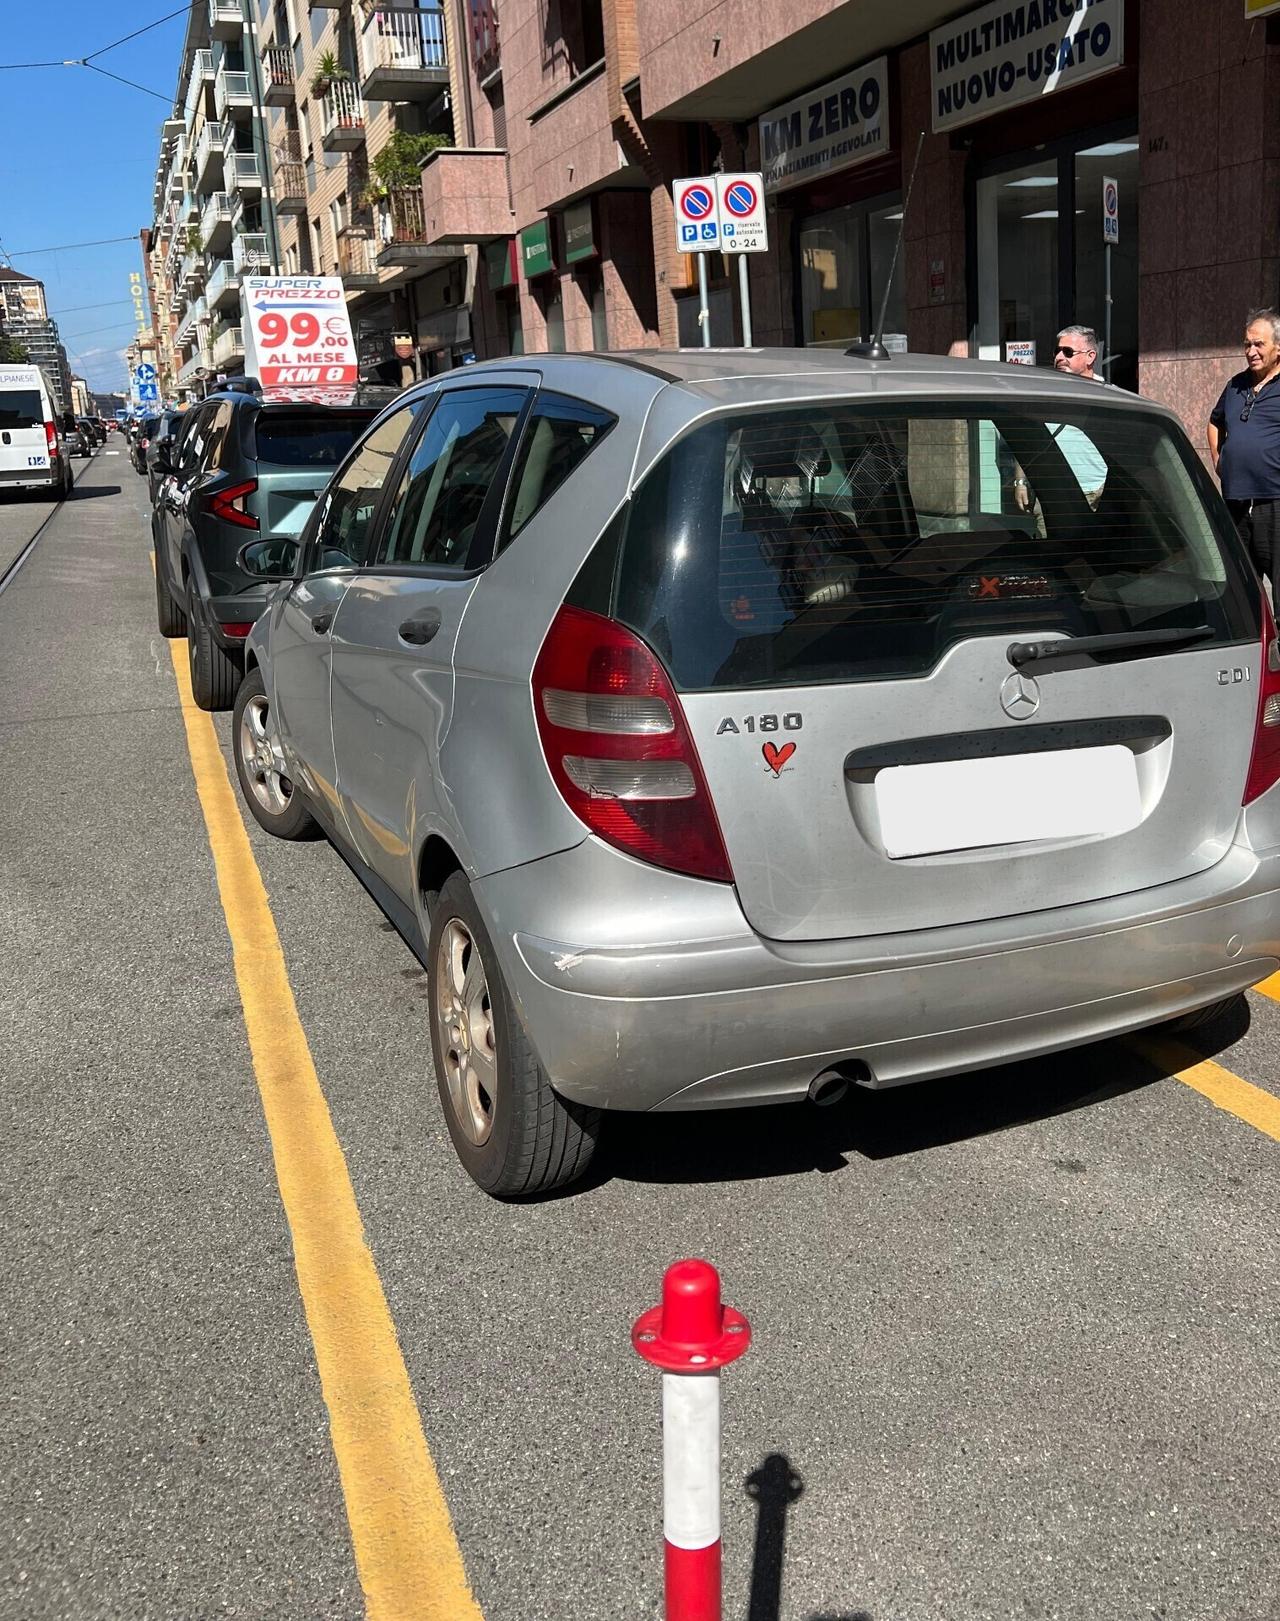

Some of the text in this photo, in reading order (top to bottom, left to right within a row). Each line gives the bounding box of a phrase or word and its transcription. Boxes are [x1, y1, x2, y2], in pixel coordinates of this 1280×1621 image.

[937, 0, 1104, 73] MULTIMARC
[938, 22, 1111, 117] NUOVO-USATO
[763, 77, 880, 161] KM ZERO
[831, 126, 881, 160] AGEVOLATI
[730, 239, 737, 248] 0
[744, 238, 757, 248] 24
[249, 279, 321, 288] SUPER
[255, 290, 340, 299] PREZZO
[258, 312, 321, 348] 99
[268, 352, 345, 365] AL MESE
[277, 367, 321, 383] KM
[1217, 666, 1250, 686] CDI
[716, 712, 803, 735] A180
